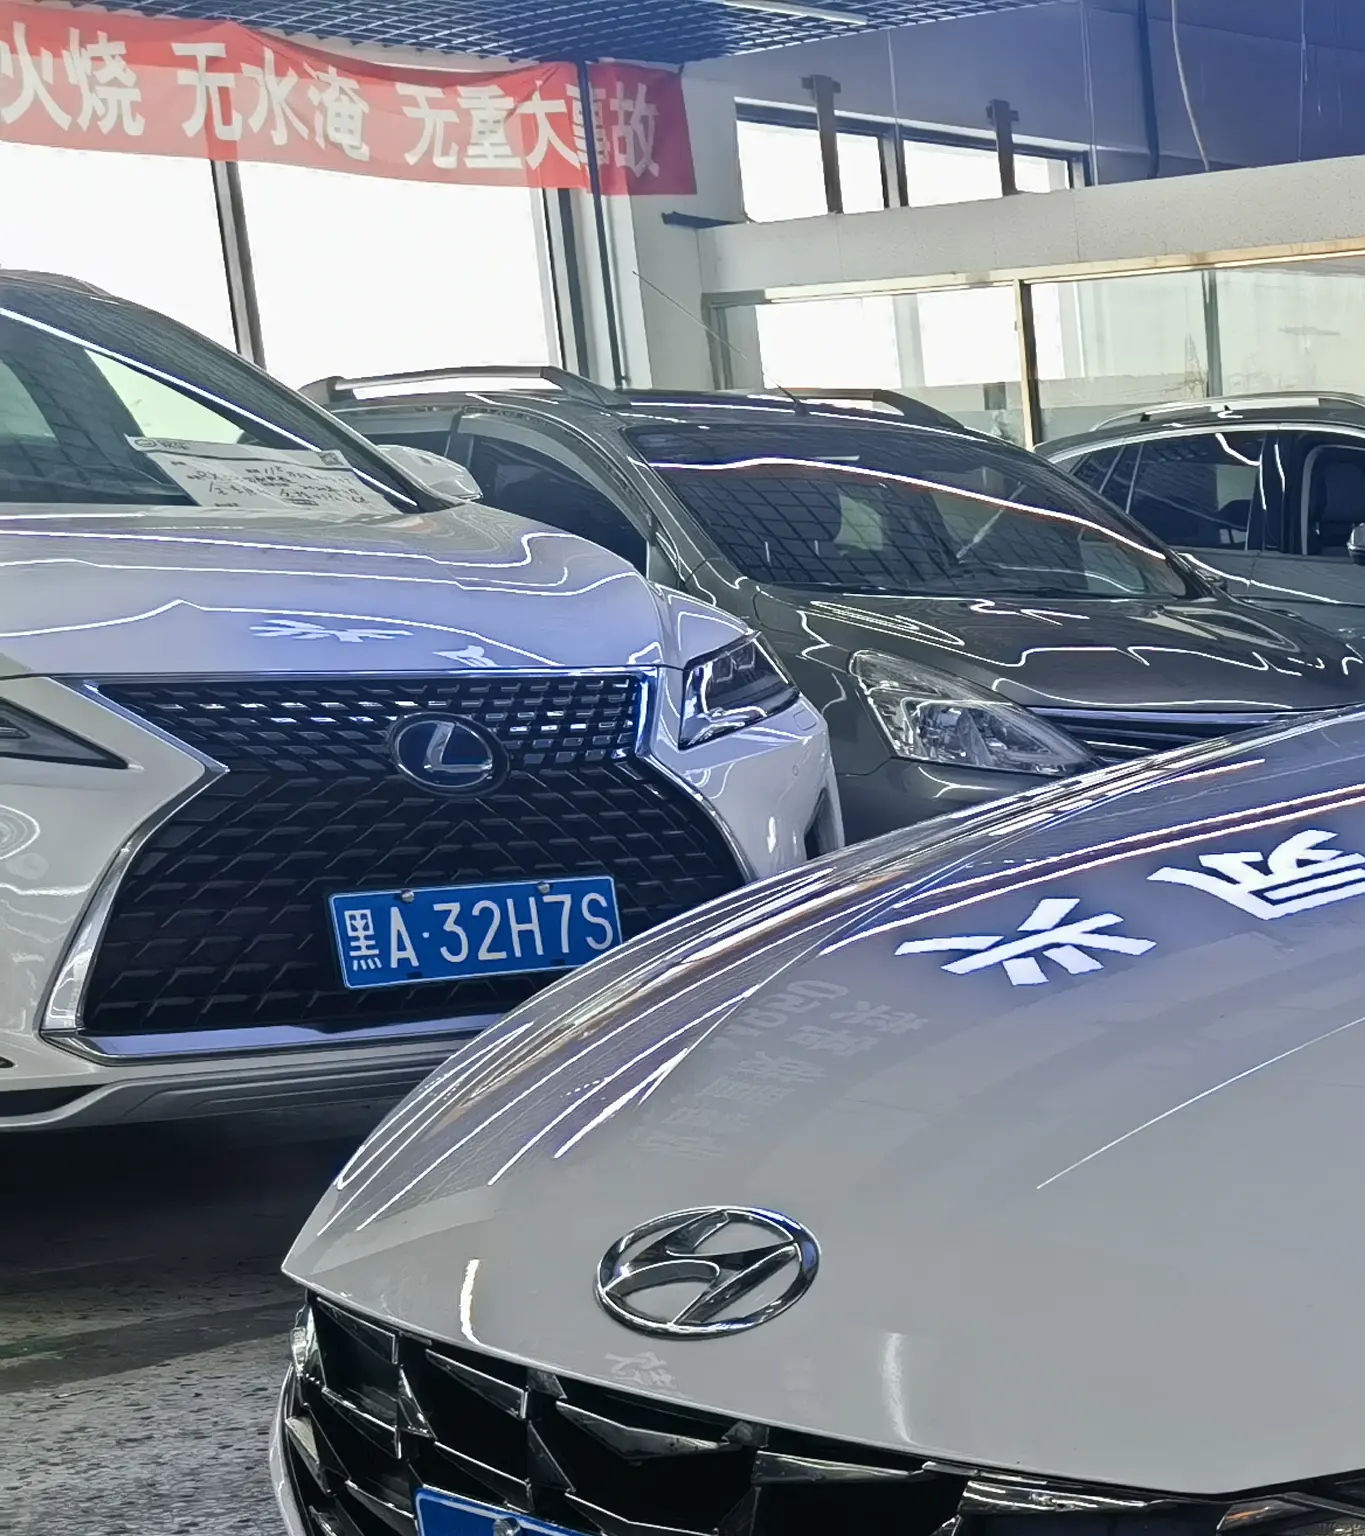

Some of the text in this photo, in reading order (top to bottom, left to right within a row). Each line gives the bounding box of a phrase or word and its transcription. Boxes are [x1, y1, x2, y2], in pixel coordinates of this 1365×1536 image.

[0, 20, 146, 136] 火烧
[171, 41, 371, 162] 无水淹
